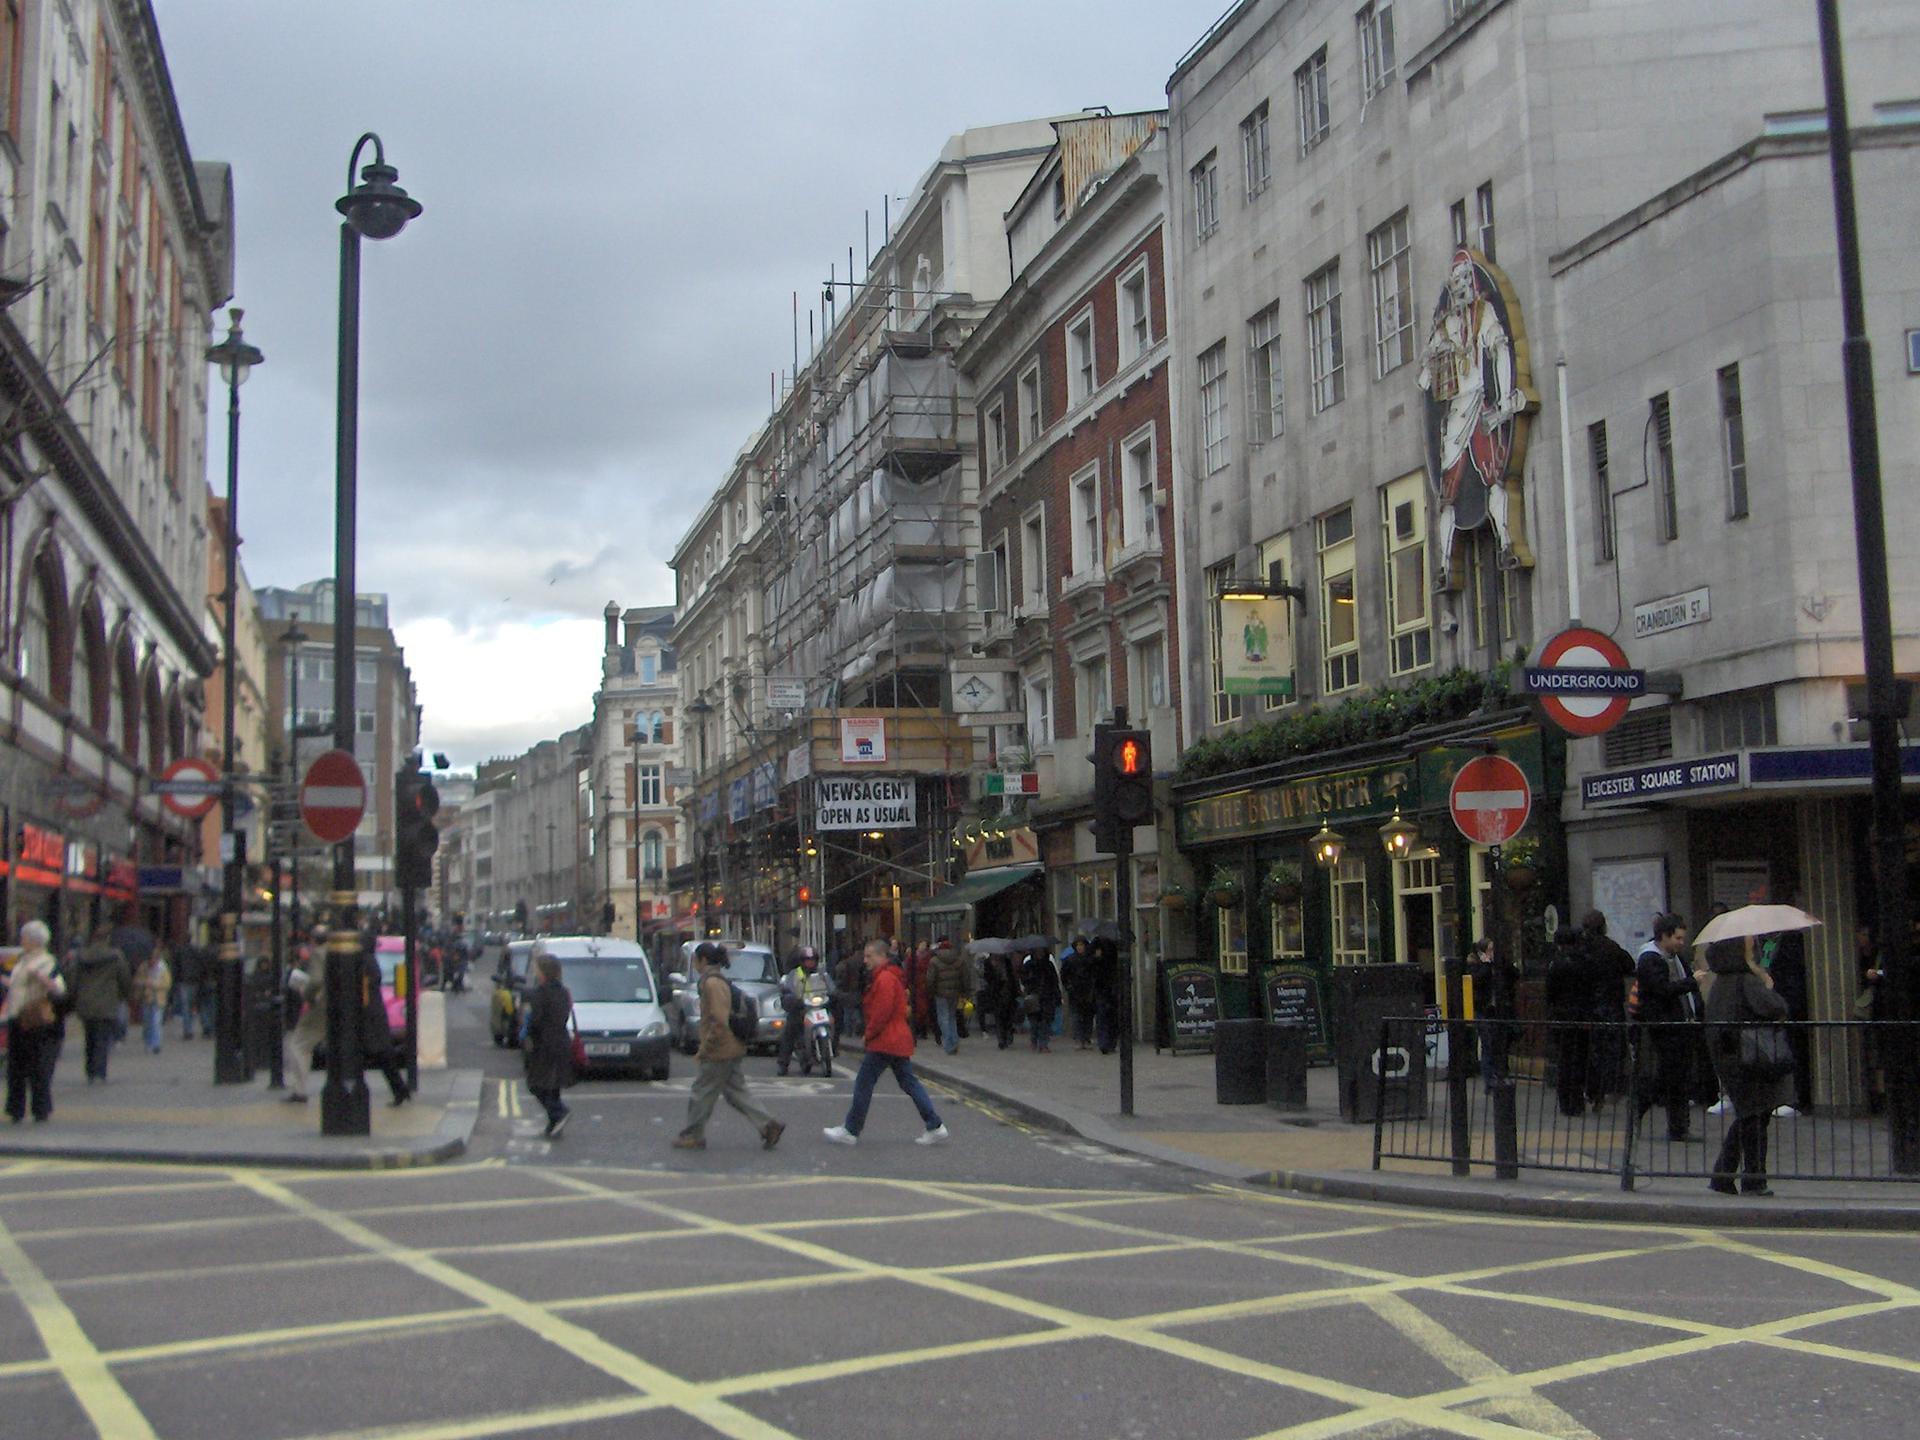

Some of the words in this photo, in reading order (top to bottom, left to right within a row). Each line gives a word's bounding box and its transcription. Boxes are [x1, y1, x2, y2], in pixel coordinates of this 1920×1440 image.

[1636, 604, 1686, 633] CRANBOURN
[1529, 674, 1639, 688] UNDERGROUND
[1587, 777, 1635, 797] LEICESTER
[1641, 769, 1683, 789] SQUARE
[1690, 761, 1736, 783] STATION
[820, 782, 910, 802] NEWSAGENT
[1211, 801, 1241, 829] THE
[1248, 776, 1372, 824] BREWMASTER
[822, 808, 852, 825] OPEN
[856, 808, 870, 823] AS
[874, 807, 911, 822] USUAL
